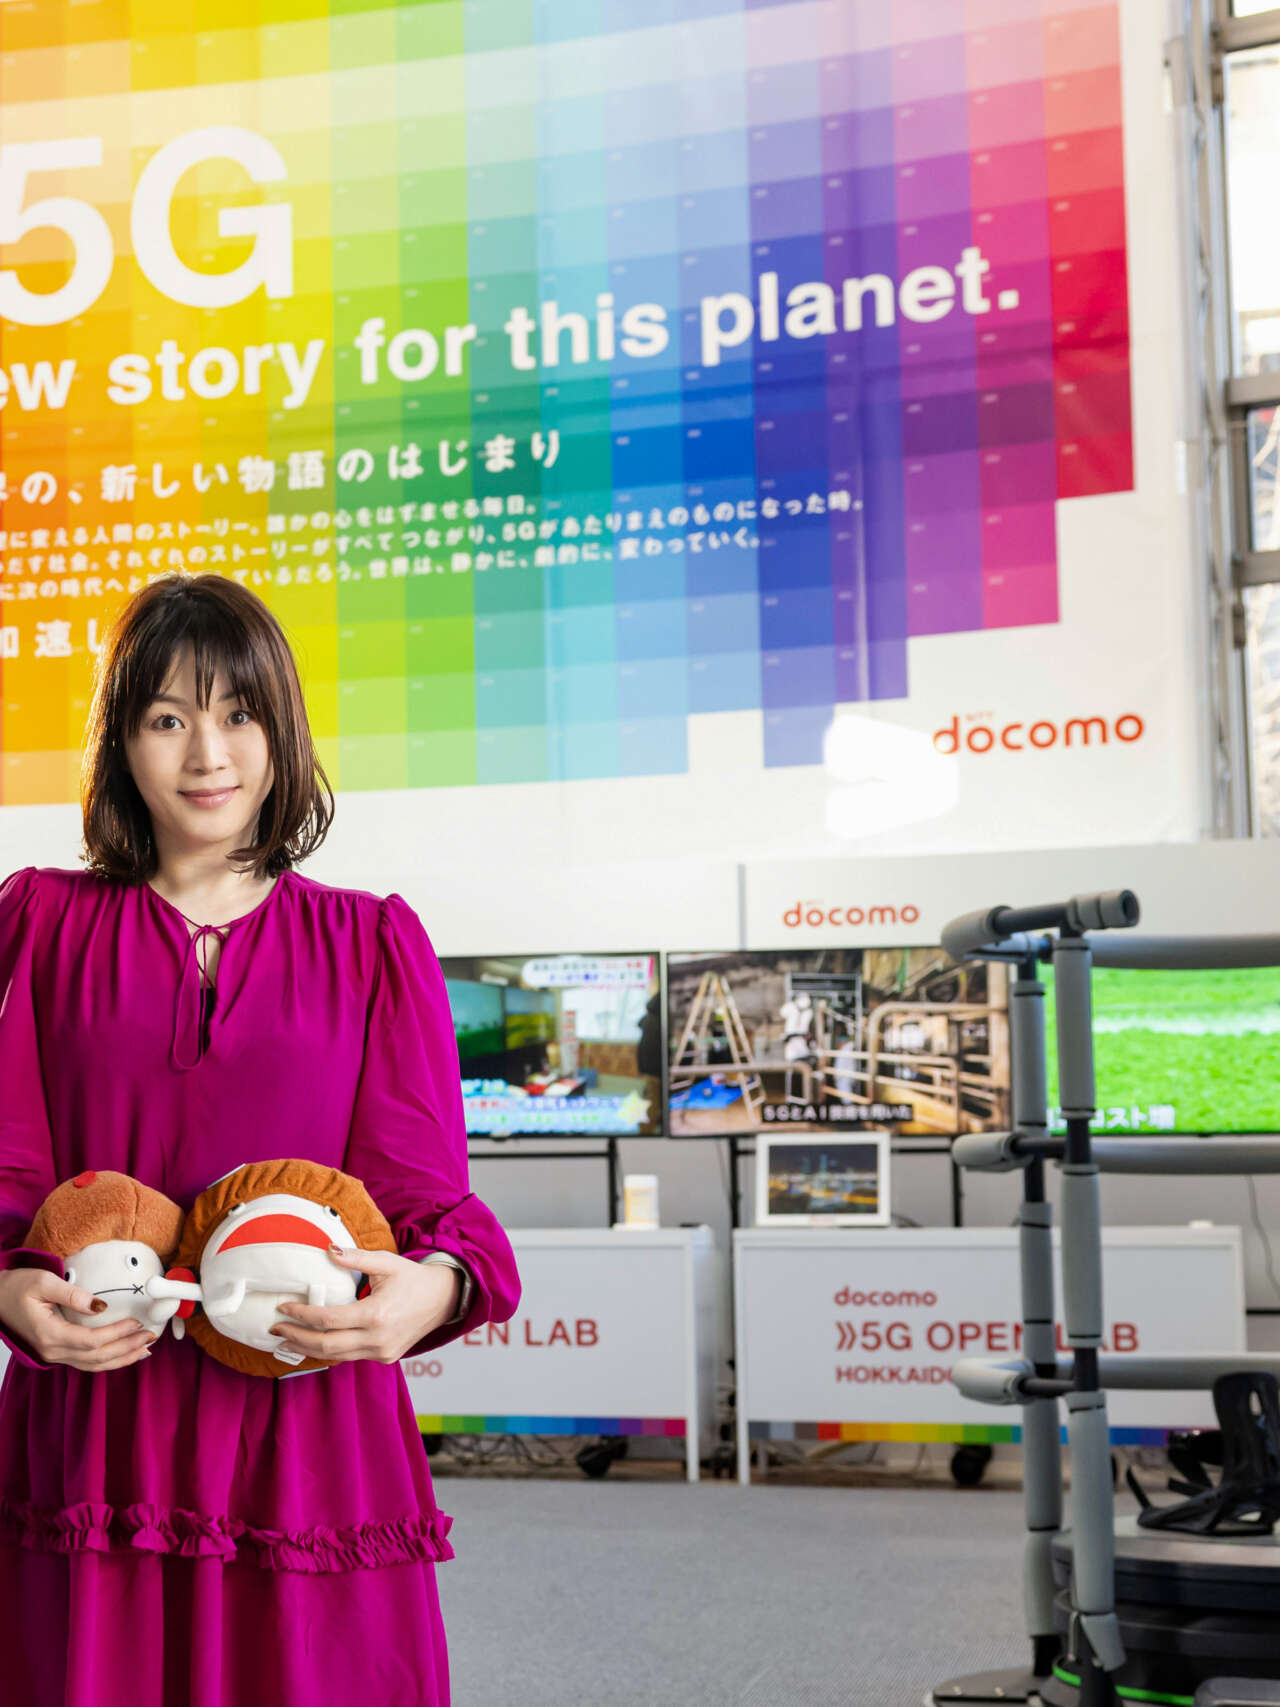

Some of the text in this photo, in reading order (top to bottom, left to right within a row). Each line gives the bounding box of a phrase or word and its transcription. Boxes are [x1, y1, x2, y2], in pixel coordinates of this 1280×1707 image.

[107, 338, 324, 410] story
[355, 317, 476, 384] for
[505, 292, 669, 370] this
[701, 247, 1020, 367] planet.
[933, 713, 1144, 755] docomo
[783, 902, 921, 928] docomo
[834, 1286, 937, 1306] docomo
[524, 1319, 599, 1347] LAB
[1055, 1323, 1140, 1352] LB
